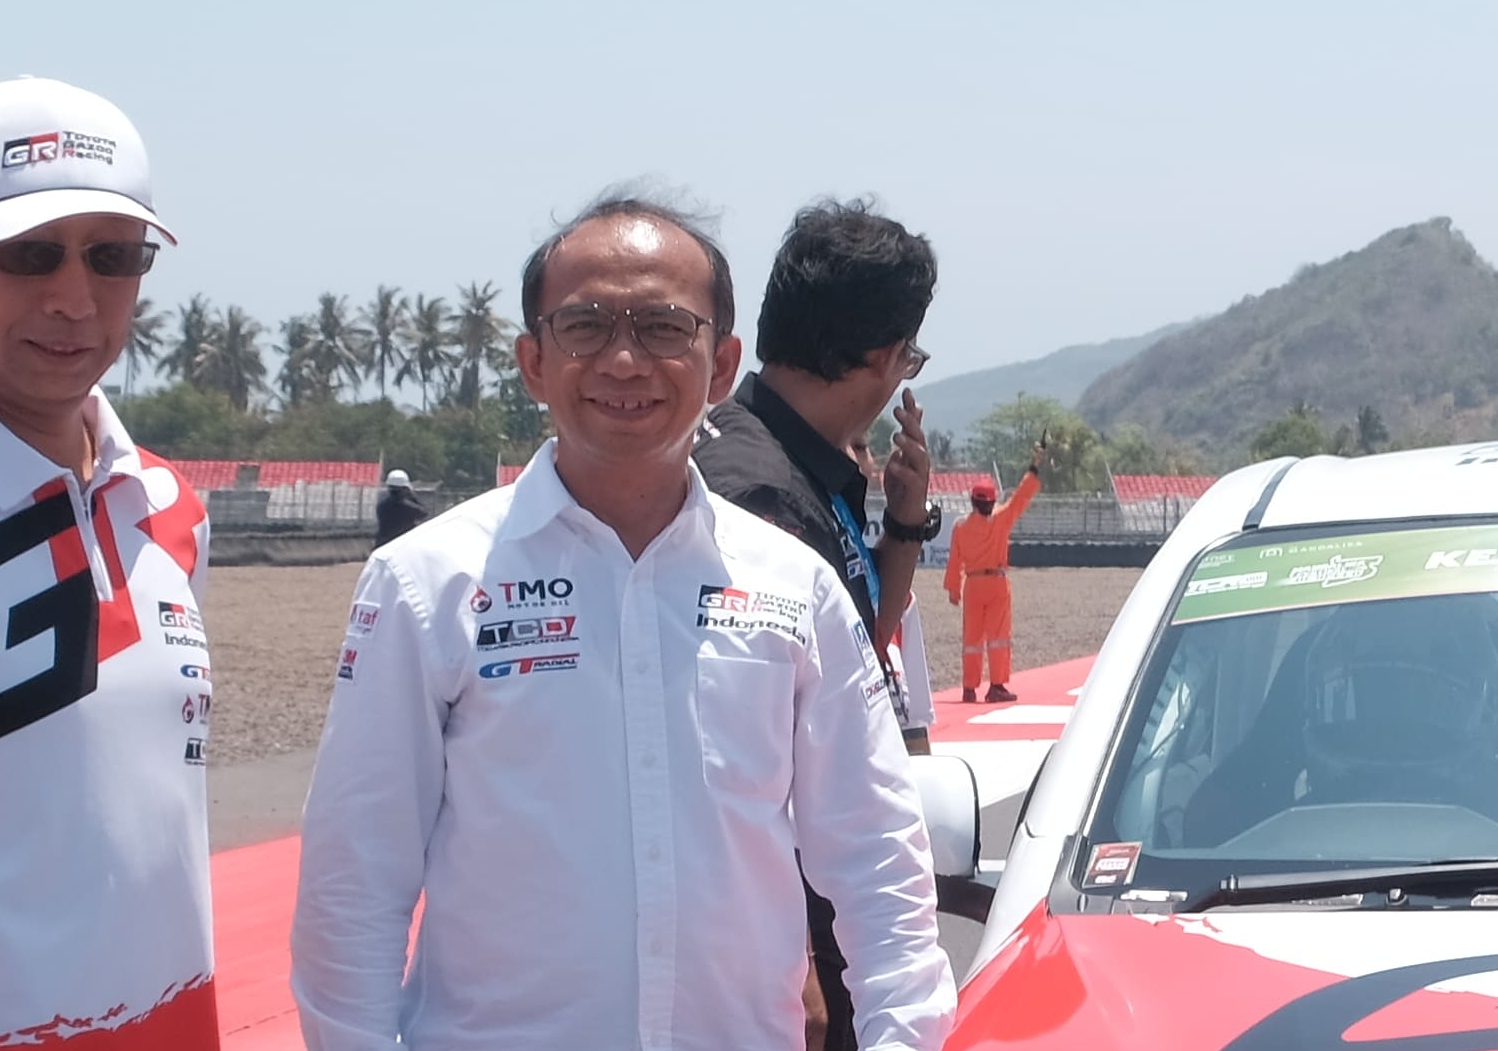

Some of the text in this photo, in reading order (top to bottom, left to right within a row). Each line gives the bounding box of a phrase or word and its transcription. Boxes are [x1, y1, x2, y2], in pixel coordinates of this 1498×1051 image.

[3, 138, 58, 167] GR
[498, 578, 573, 603] TMO
[480, 617, 571, 645] TCD
